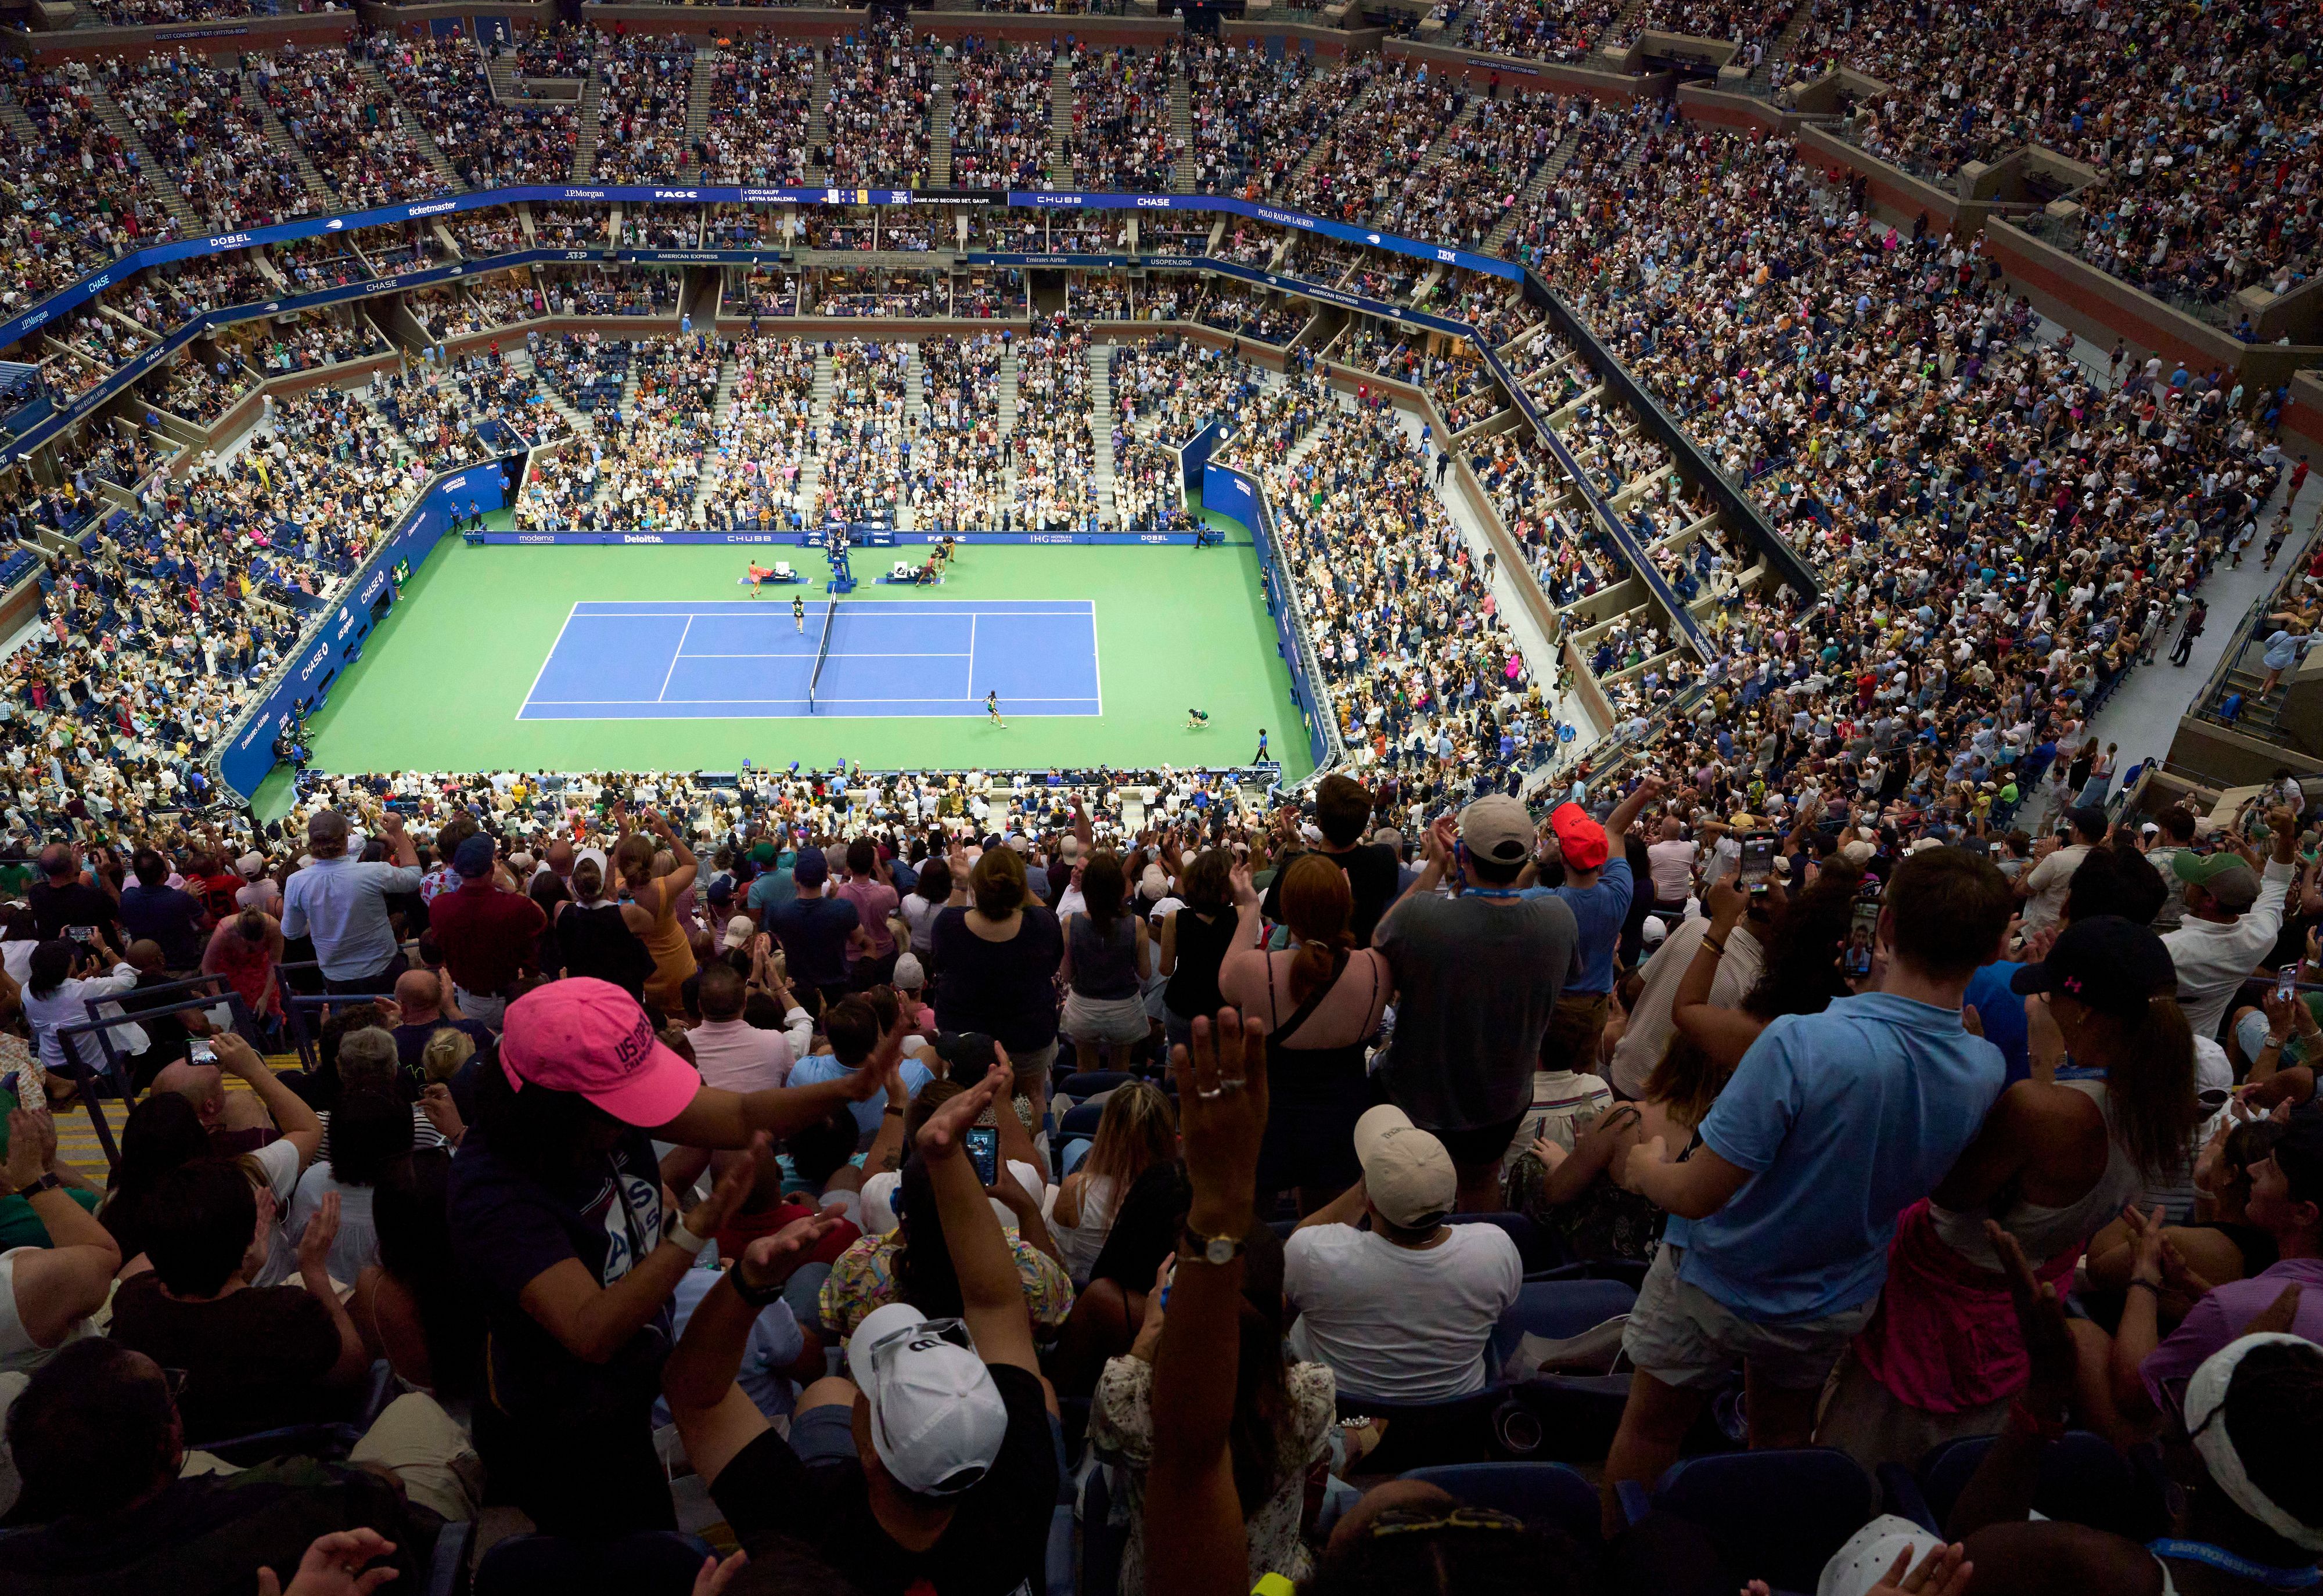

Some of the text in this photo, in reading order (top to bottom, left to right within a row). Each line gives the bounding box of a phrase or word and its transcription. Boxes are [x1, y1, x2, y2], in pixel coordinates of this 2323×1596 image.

[1479, 60, 1500, 69] CONCERN?
[409, 202, 456, 216] ticketmaster
[1137, 198, 1170, 206] CHASE
[1258, 208, 1314, 228] POLO RALPH LAUREN
[210, 234, 251, 247] DOBEL
[1437, 249, 1456, 262] IBM
[89, 275, 110, 293] CHASE
[366, 279, 397, 291] CHASE
[1309, 288, 1358, 305] AMERICAN EXPRESS
[146, 347, 164, 363] FAGE
[74, 402, 84, 413] POLO
[84, 395, 95, 406] RALPH
[443, 476, 465, 491] AMERICAN
[446, 481, 466, 493] EXPRESS
[361, 577, 380, 604] CHASE
[301, 649, 323, 681] CHASE
[279, 712, 289, 729] IBM
[241, 712, 270, 750] Emirates Airline
[614, 1036, 638, 1062] US
